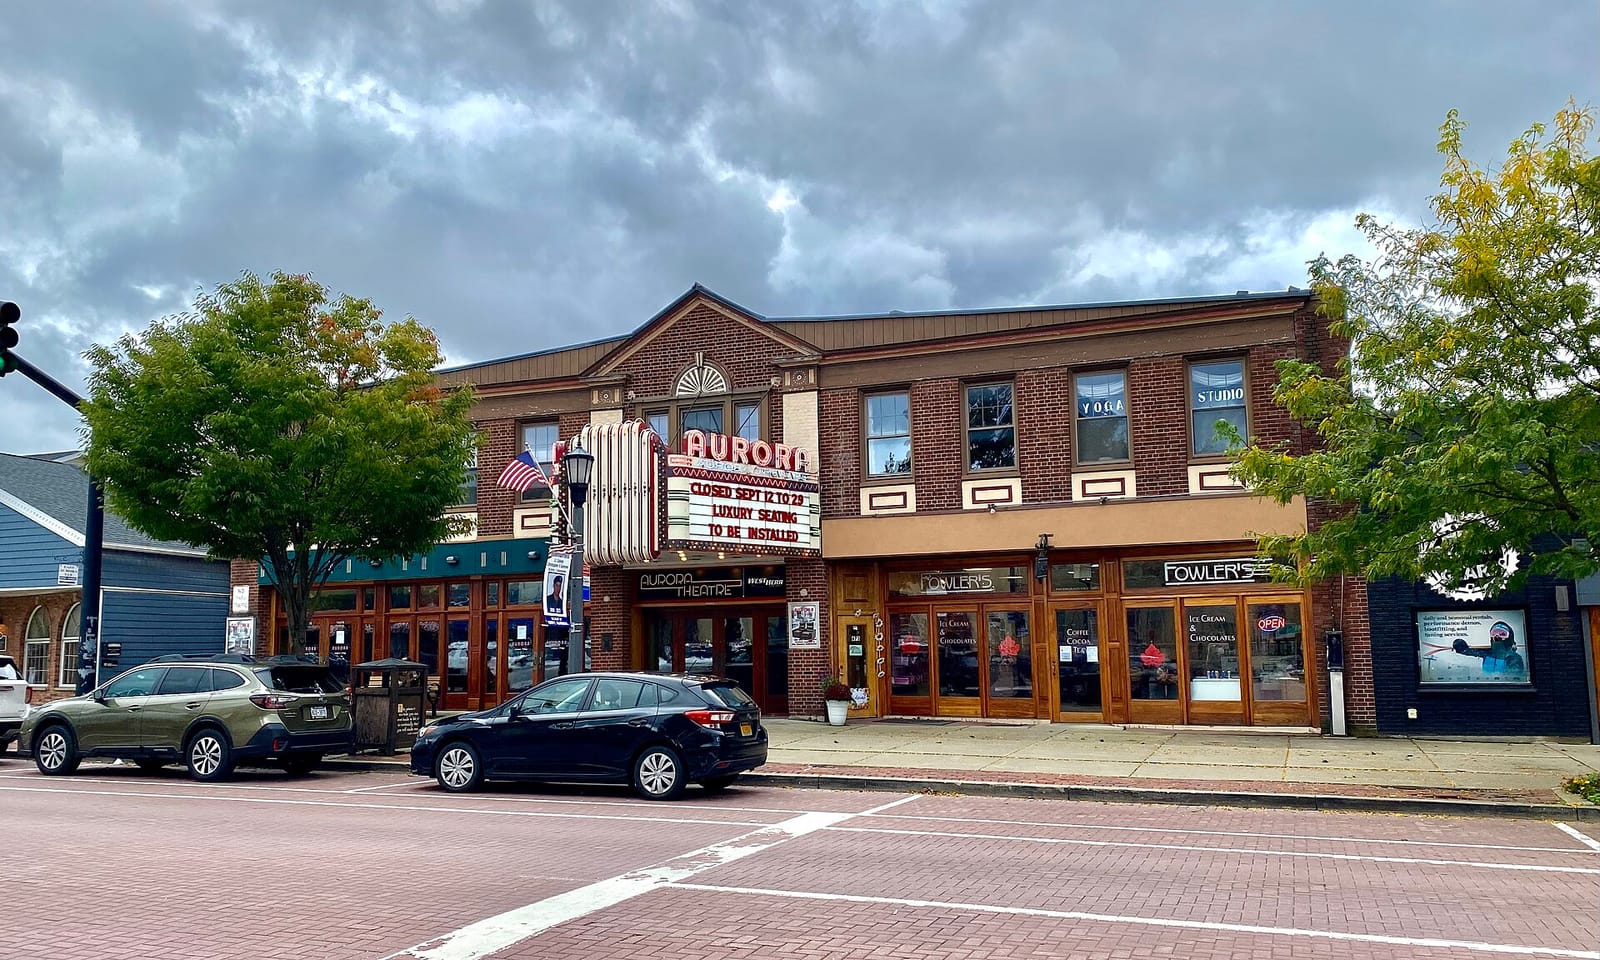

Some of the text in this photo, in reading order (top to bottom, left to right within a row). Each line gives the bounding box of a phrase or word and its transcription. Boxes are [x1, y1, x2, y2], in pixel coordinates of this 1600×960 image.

[1198, 388, 1244, 403] STUDIO
[1083, 400, 1125, 414] YOGA
[683, 430, 812, 473] AURORA
[690, 482, 732, 499] CLOSED
[735, 487, 761, 501] SEPT
[764, 490, 775, 503] 12
[776, 492, 789, 504] TO
[712, 504, 798, 524] LUXURY SEATING
[708, 523, 799, 542] TO BE INSTALLED
[1165, 563, 1255, 582] FOWLER'S
[641, 573, 693, 587] AURORA
[921, 574, 993, 590] FOWLER'S
[677, 584, 732, 597] THEATRE
[1201, 614, 1226, 622] CREAM
[1258, 618, 1285, 629] OPEN
[1066, 628, 1089, 636] COFFEE
[1189, 634, 1236, 642] CHOCOLATES
[1066, 637, 1091, 645] COCOA
